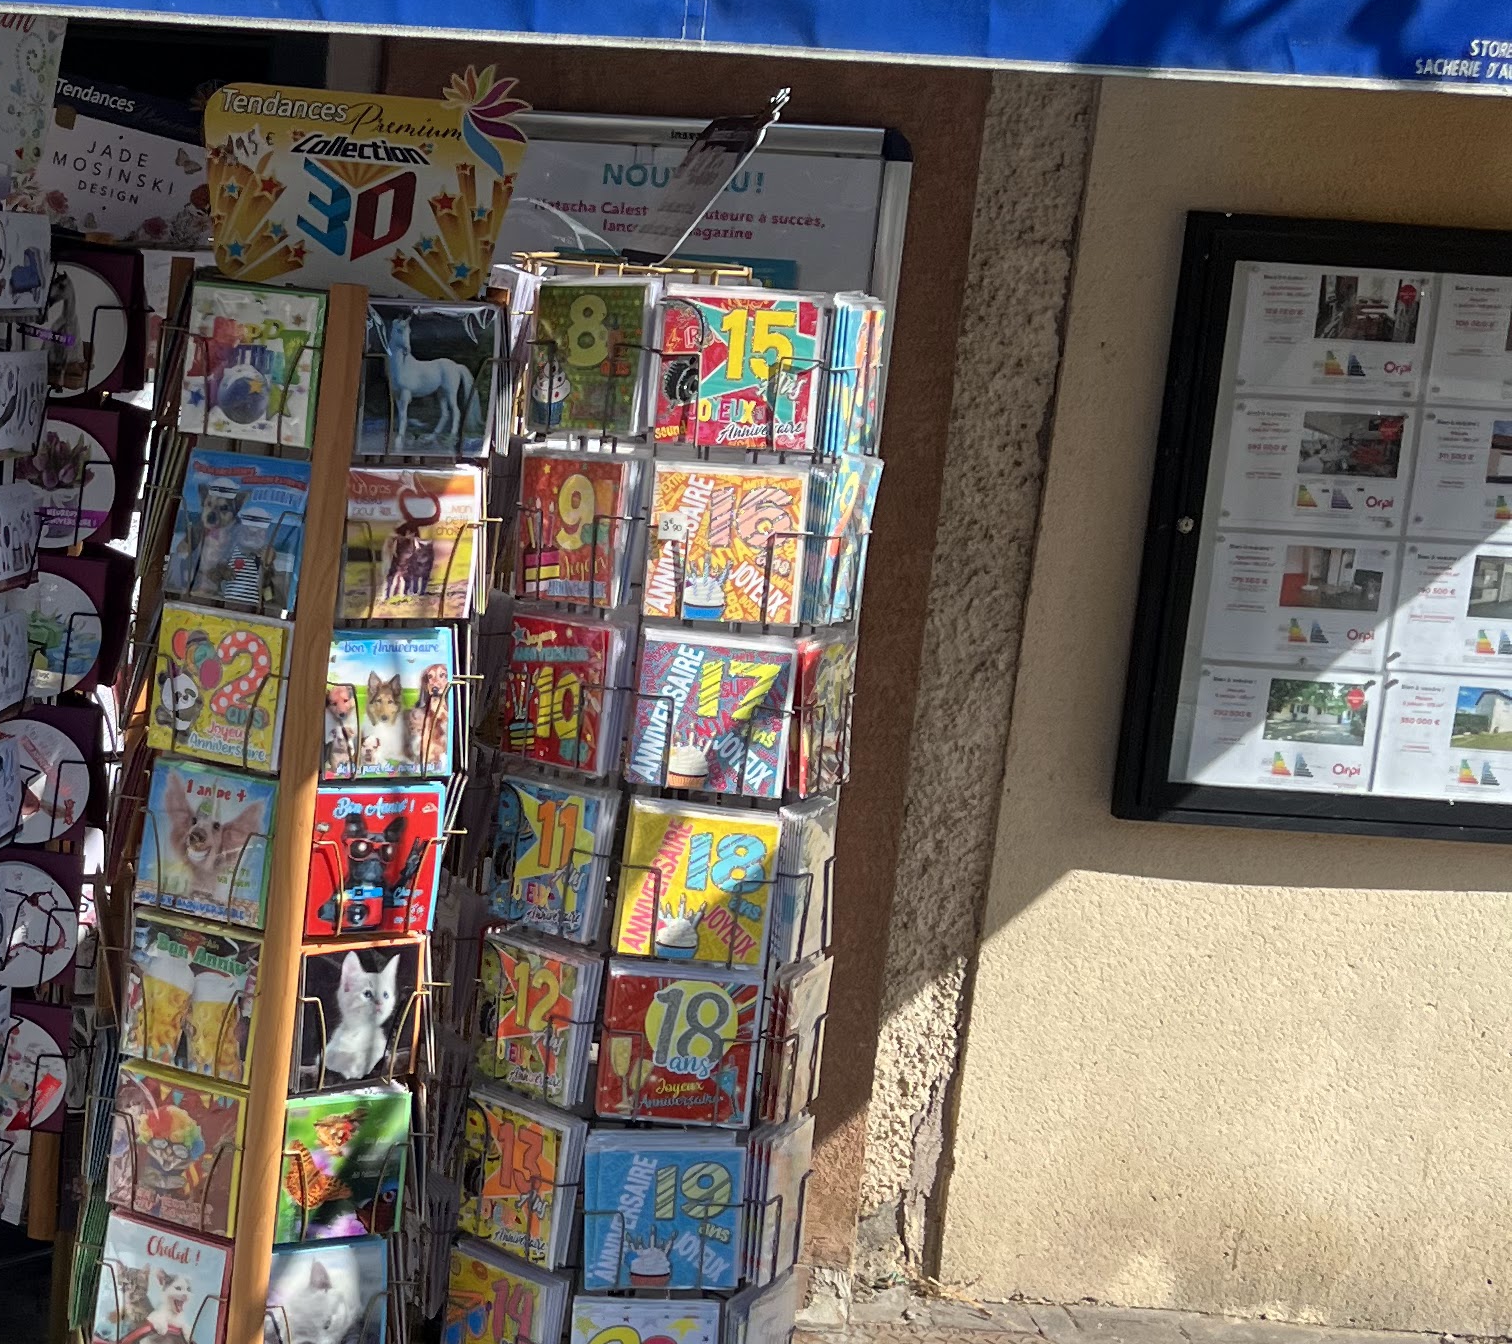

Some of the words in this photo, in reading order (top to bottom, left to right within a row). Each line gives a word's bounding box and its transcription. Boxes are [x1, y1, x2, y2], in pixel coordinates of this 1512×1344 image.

[1415, 58, 1482, 77] SACHERIE
[56, 77, 136, 113] Tendances
[221, 88, 349, 123] Tendances
[347, 103, 464, 142] Premium
[87, 141, 149, 167] JADE
[290, 133, 430, 166] Collection
[52, 151, 174, 195] MOSINSKI
[77, 179, 139, 204] DESIGN
[296, 156, 417, 262] 3D
[703, 211, 754, 223] uteure
[689, 228, 753, 241] agazine
[567, 294, 609, 367] 8
[721, 308, 797, 382] 15
[1383, 361, 1412, 376] Orpi
[555, 473, 595, 550] 9
[708, 486, 794, 549] 16
[1365, 496, 1394, 510] Orpi
[344, 642, 365, 653] Bon
[373, 640, 440, 655] Anniversaire
[1346, 629, 1375, 643] Orpi
[210, 630, 272, 717] 2
[696, 659, 782, 721] 17
[536, 666, 581, 740] 10
[208, 720, 246, 741] Joyeu
[712, 731, 774, 791] JOYEUX
[1332, 763, 1361, 777] Orpi
[332, 797, 364, 819] Bon
[537, 800, 580, 869] 11
[685, 831, 768, 895] 18
[702, 905, 757, 960] JOYEUX
[514, 961, 560, 1032] 12
[654, 988, 730, 1066] 18
[655, 1077, 705, 1095] Joyeux
[669, 1056, 718, 1079] ans
[639, 1093, 720, 1109] Anniversaire
[497, 1119, 544, 1195] 13
[654, 1161, 733, 1220] 19
